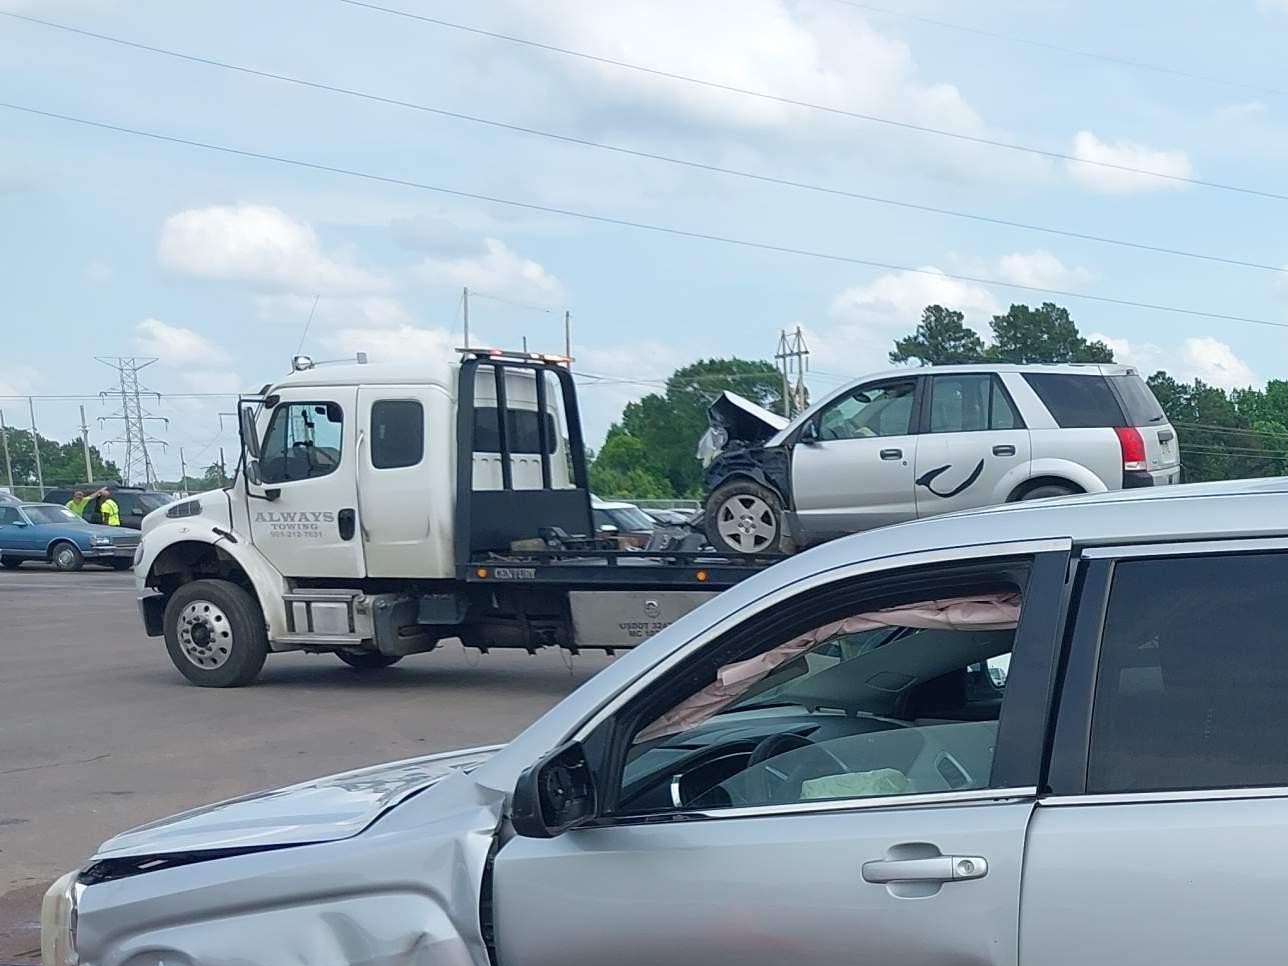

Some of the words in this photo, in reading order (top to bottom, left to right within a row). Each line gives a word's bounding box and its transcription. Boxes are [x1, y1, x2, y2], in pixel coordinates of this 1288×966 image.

[255, 511, 335, 523] ALWAYS
[495, 567, 536, 579] CENTURY
[619, 622, 648, 630] USDOT
